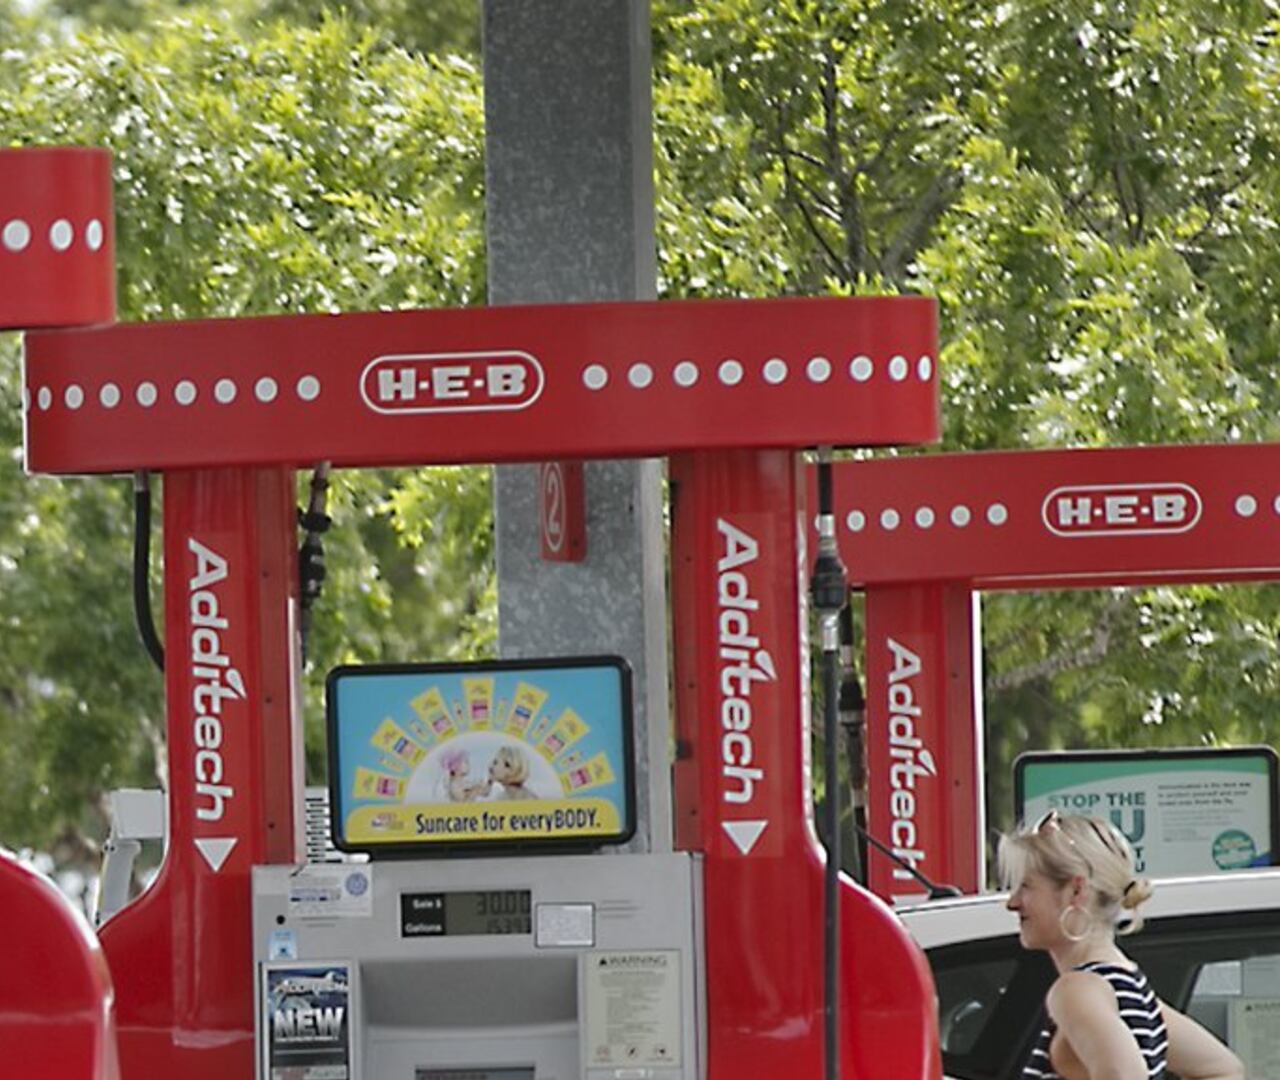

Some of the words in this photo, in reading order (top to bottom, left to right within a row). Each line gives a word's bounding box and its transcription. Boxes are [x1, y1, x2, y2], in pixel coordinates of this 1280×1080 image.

[548, 472, 560, 533] 2
[187, 538, 246, 822] Additech
[716, 518, 776, 804] Additech
[885, 637, 938, 882] Additech
[415, 813, 477, 835] Suncare
[482, 811, 506, 832] for
[509, 807, 601, 833] everyBODY.
[1048, 792, 1101, 809] STOP
[1105, 790, 1146, 806] THE
[273, 1006, 344, 1038] NEW
